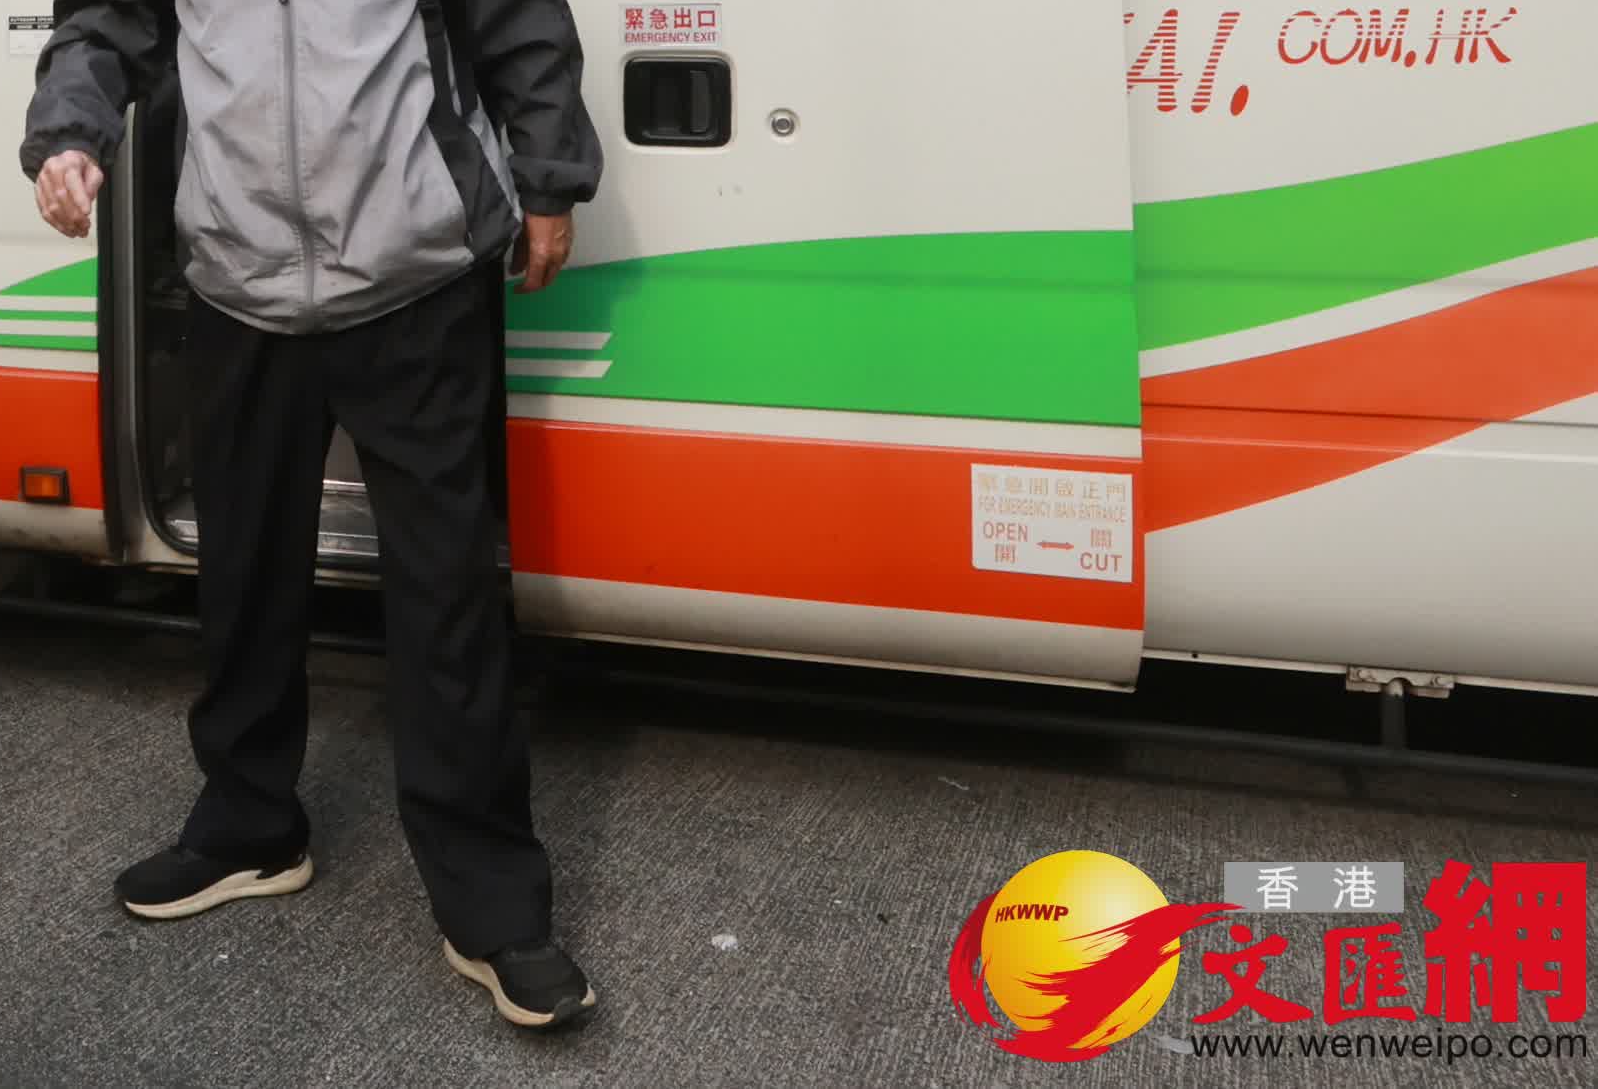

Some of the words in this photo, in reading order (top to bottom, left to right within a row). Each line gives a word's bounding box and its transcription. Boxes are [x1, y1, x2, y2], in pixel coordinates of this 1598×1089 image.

[625, 7, 716, 30] 緊急出口
[624, 32, 691, 43] EMERGENCY
[693, 31, 718, 43] EXIT
[983, 521, 1029, 542] OPEN
[994, 542, 1017, 564] 開
[1080, 552, 1123, 573] CUT
